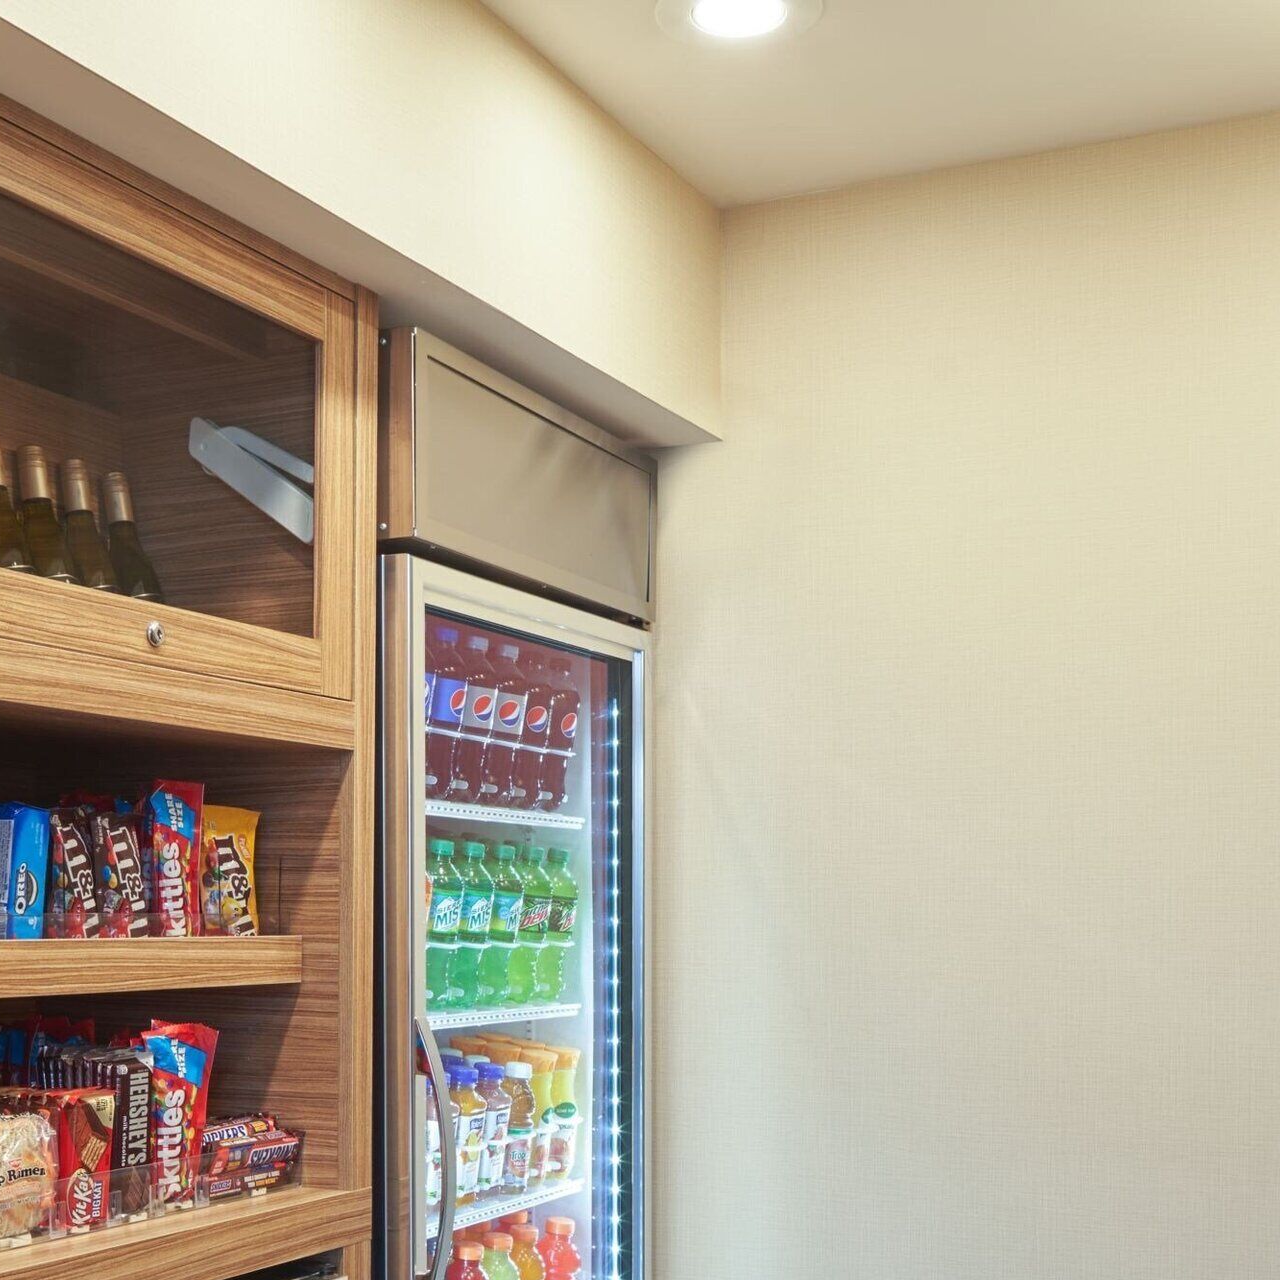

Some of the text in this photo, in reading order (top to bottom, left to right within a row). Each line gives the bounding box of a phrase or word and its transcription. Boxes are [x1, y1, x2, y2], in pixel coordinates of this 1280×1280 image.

[164, 793, 178, 832] SHARE
[177, 801, 185, 829] SIZE
[14, 862, 28, 915] OREO
[128, 1071, 150, 1166] HERSHEY'S
[157, 1089, 186, 1201] Skittles
